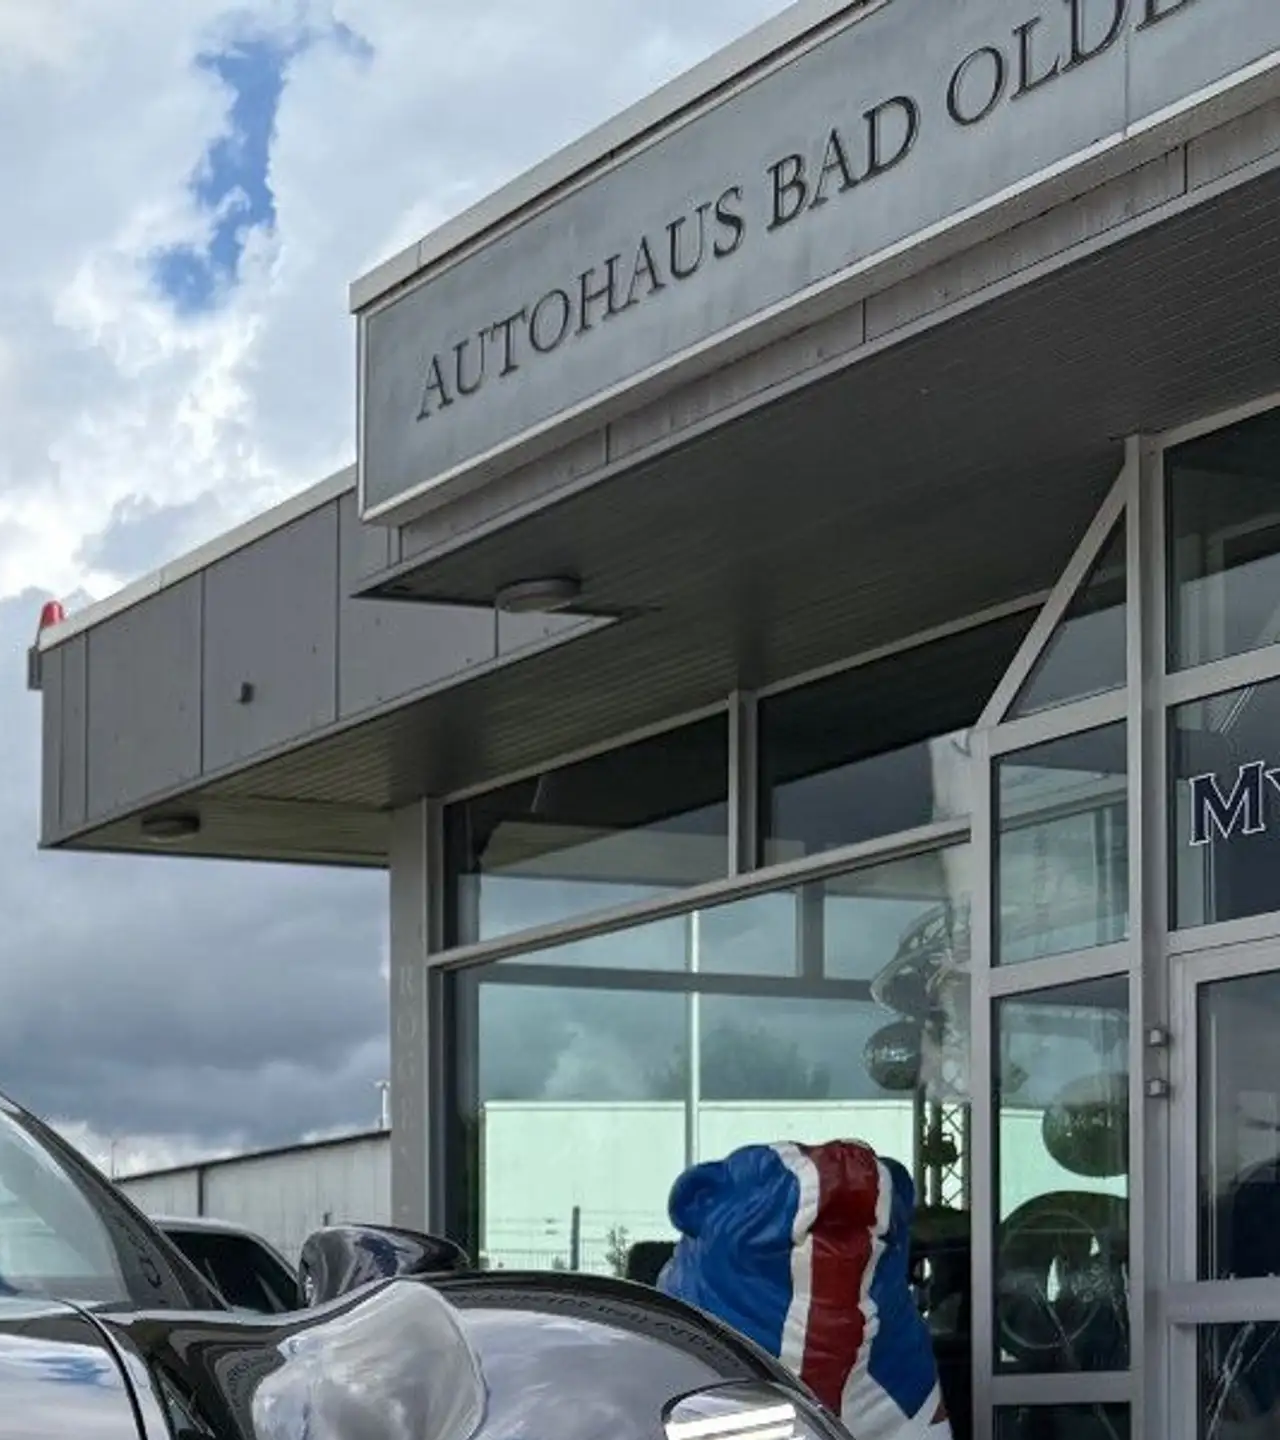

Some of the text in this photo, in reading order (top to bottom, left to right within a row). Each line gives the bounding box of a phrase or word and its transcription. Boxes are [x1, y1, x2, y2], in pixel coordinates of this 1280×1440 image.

[416, 185, 745, 422] AUTOHAUS
[766, 96, 921, 232] BAD
[1188, 760, 1280, 846] M
